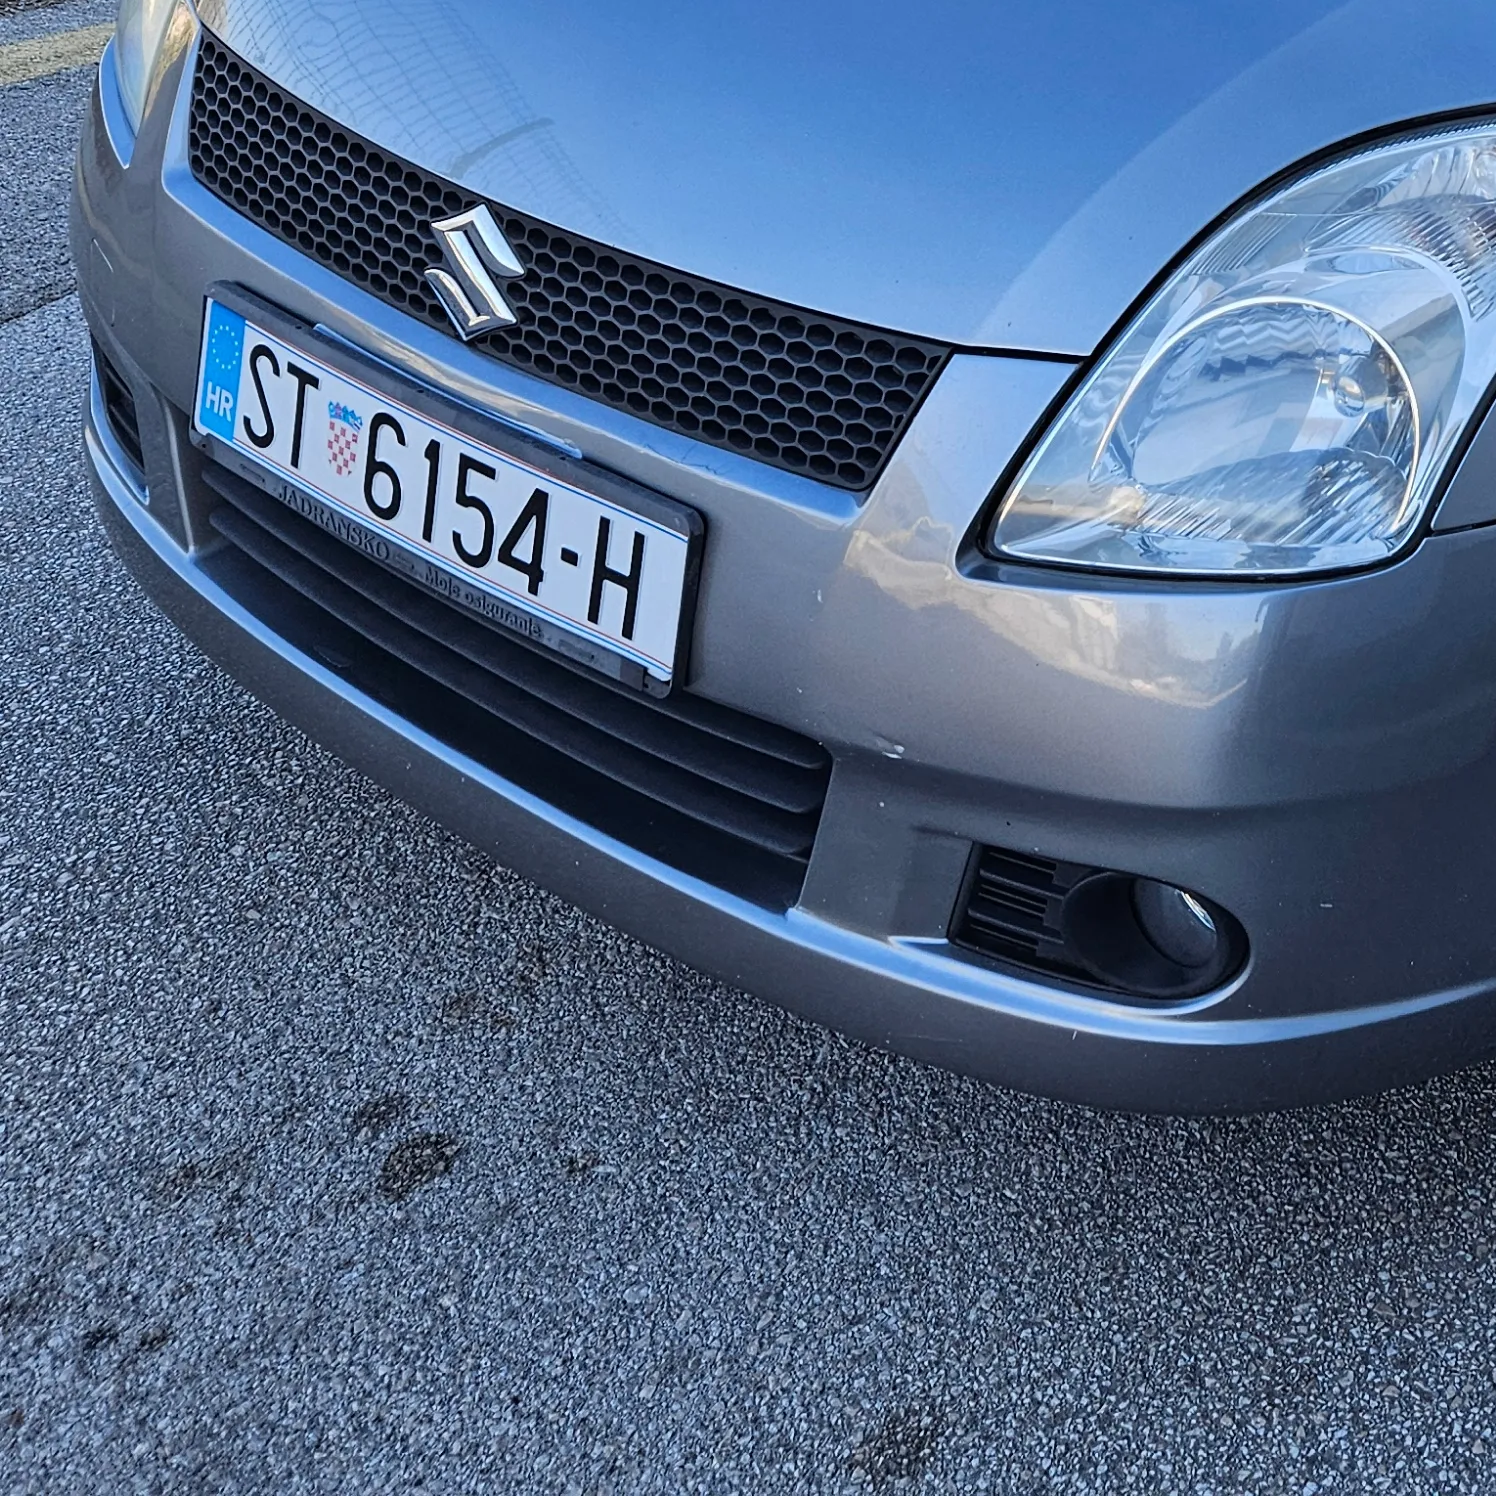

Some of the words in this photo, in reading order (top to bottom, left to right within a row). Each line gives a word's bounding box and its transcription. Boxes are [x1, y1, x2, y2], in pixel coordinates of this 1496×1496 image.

[203, 381, 235, 421] HR
[242, 342, 321, 470] ST
[362, 410, 646, 641] 6154-H
[278, 484, 391, 562] JADRANSKO
[425, 566, 461, 600] Moje
[465, 590, 544, 638] osiguranje
